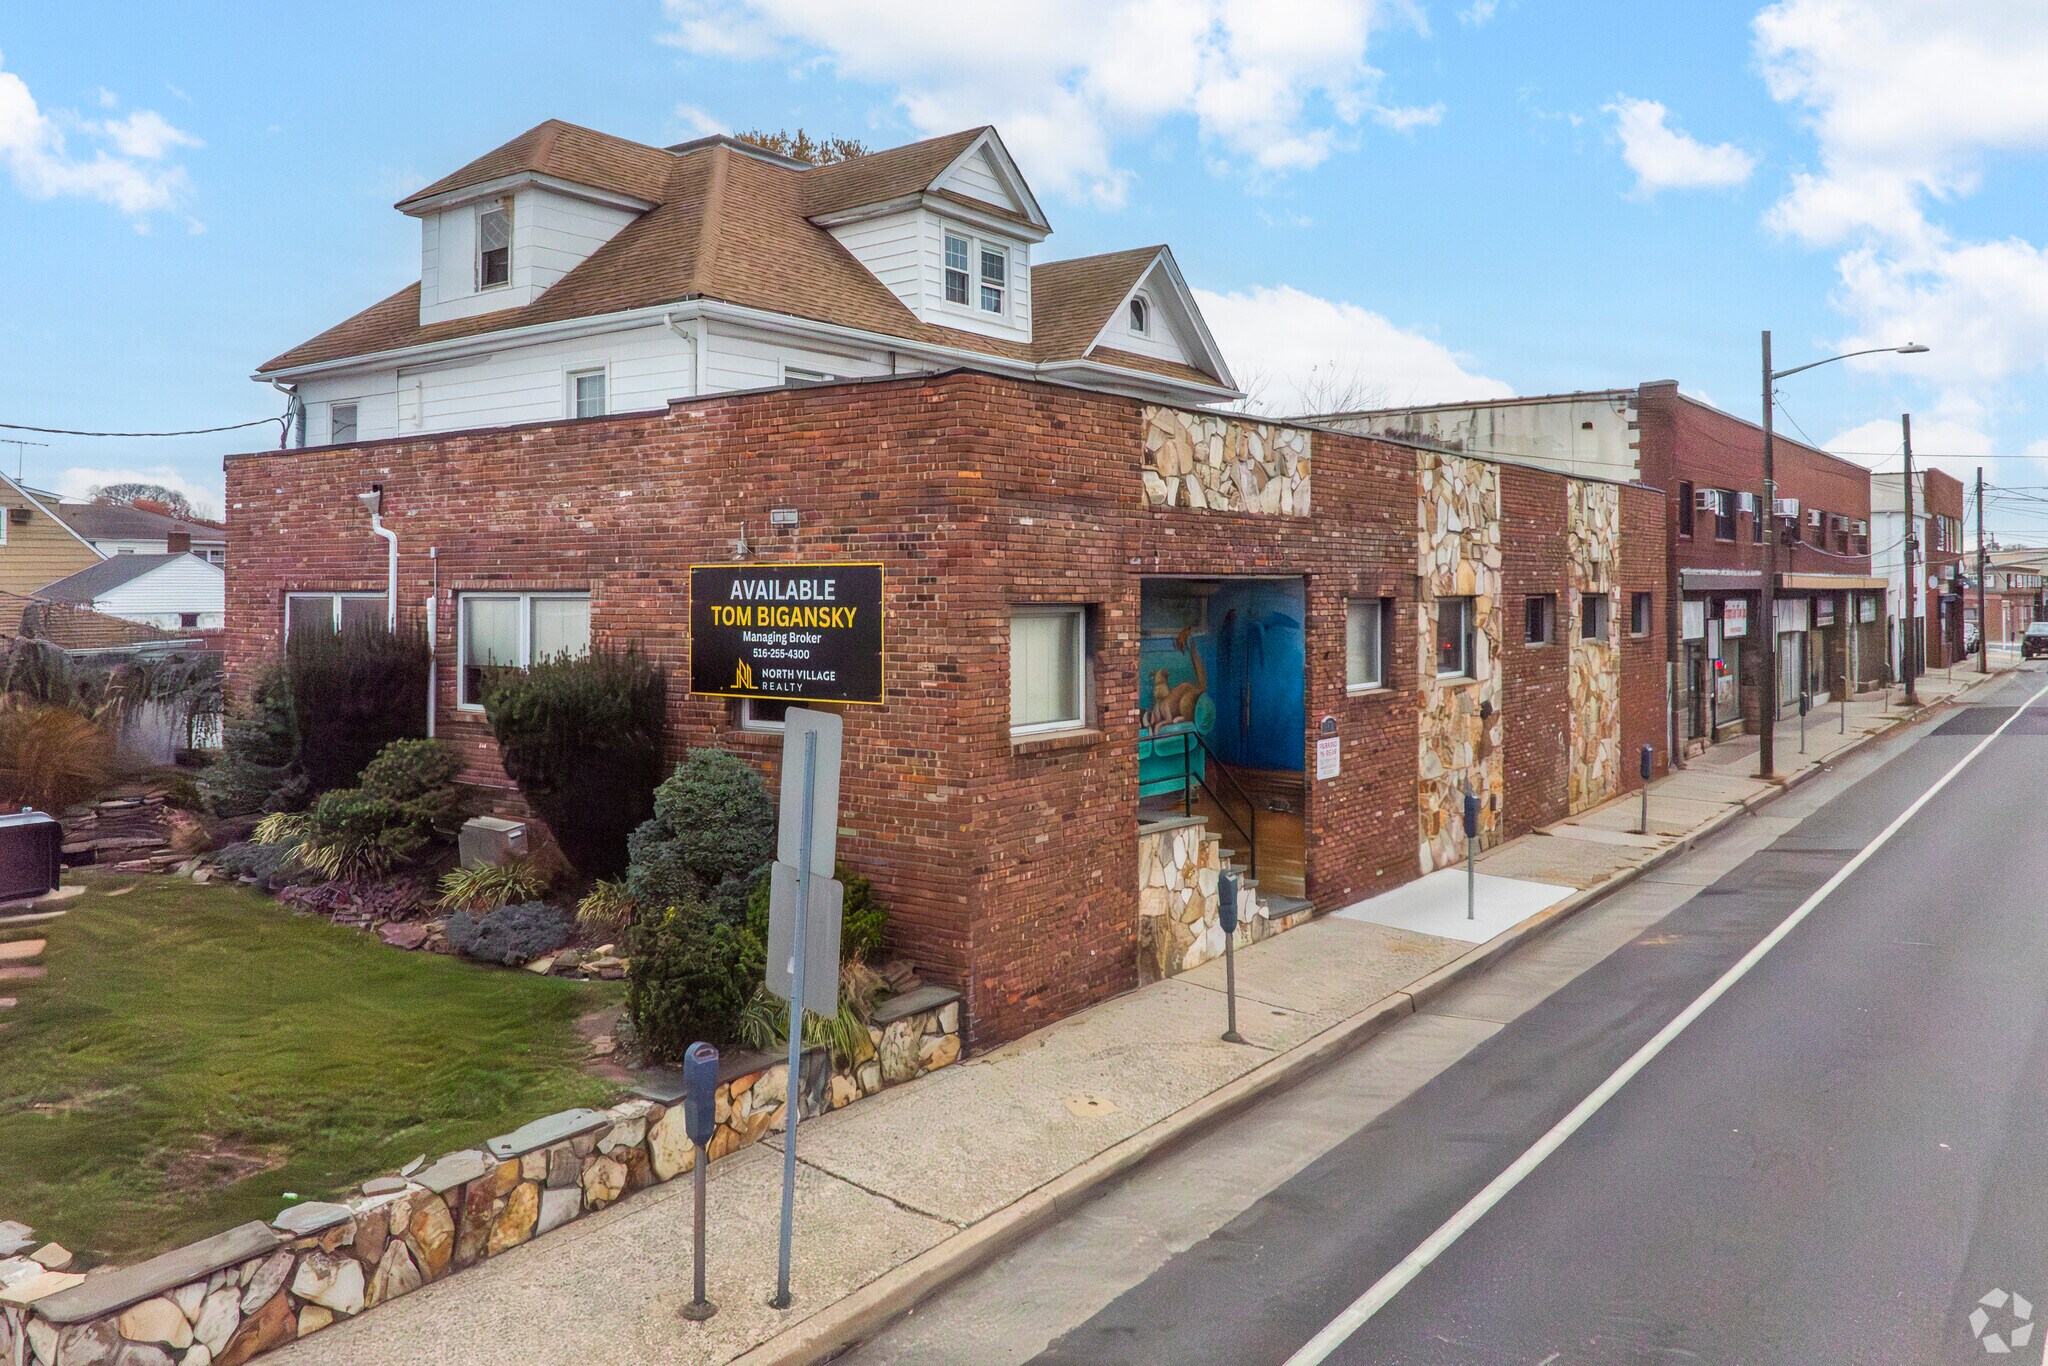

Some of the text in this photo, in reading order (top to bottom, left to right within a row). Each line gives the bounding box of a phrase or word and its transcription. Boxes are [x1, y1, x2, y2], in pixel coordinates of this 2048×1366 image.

[730, 579, 836, 600] AVAILABLE
[711, 606, 857, 628] TOM BIGANSKY
[742, 631, 821, 645] Managing Broker
[753, 648, 810, 659] 516-255-4300
[762, 668, 836, 681] NORTH VILLAGE
[762, 682, 803, 692] REALTY
